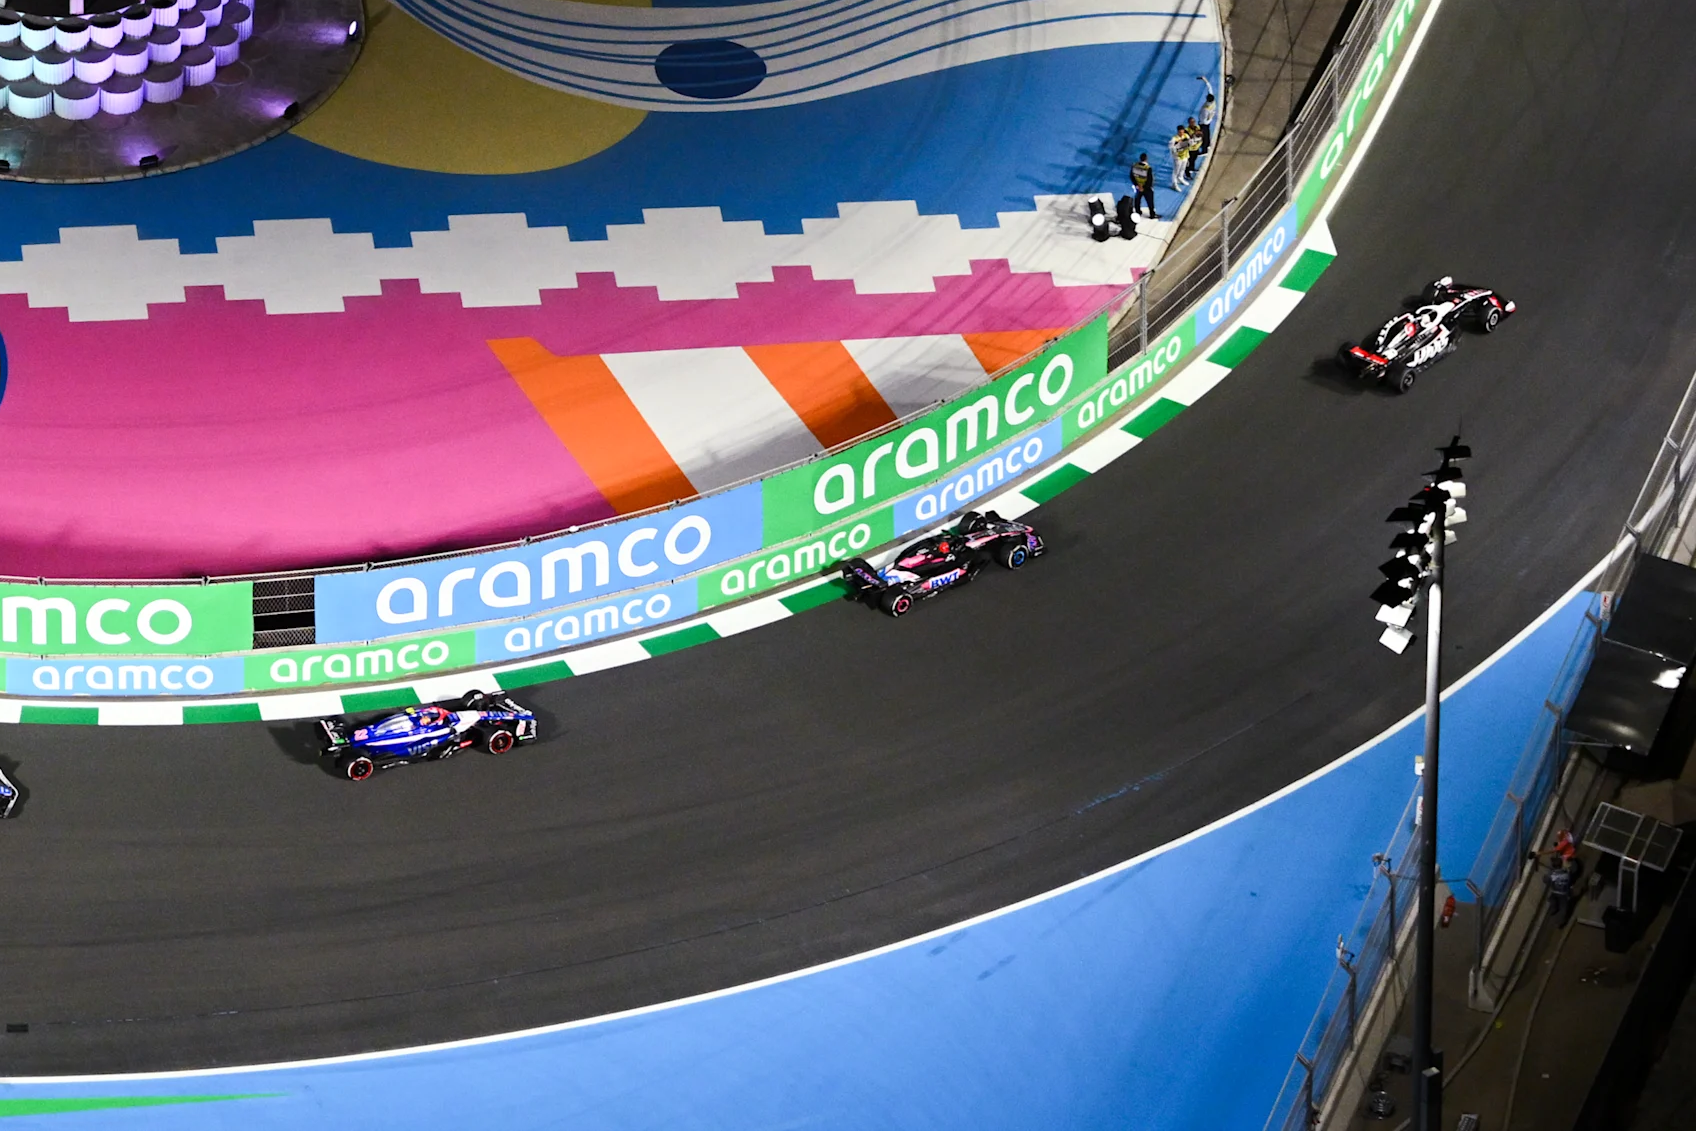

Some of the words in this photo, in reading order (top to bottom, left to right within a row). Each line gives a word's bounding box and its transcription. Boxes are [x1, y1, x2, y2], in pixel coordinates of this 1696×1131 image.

[1208, 226, 1286, 325] aramco
[1077, 335, 1182, 429] aramco
[812, 352, 1074, 515] aramco
[914, 436, 1043, 521] aramco
[375, 514, 712, 625] aramco
[720, 522, 871, 596] aramco
[931, 570, 959, 588] BWT
[504, 592, 672, 653] aramco
[31, 664, 215, 691] aramco
[269, 639, 450, 683] aramco
[354, 728, 369, 741] 22
